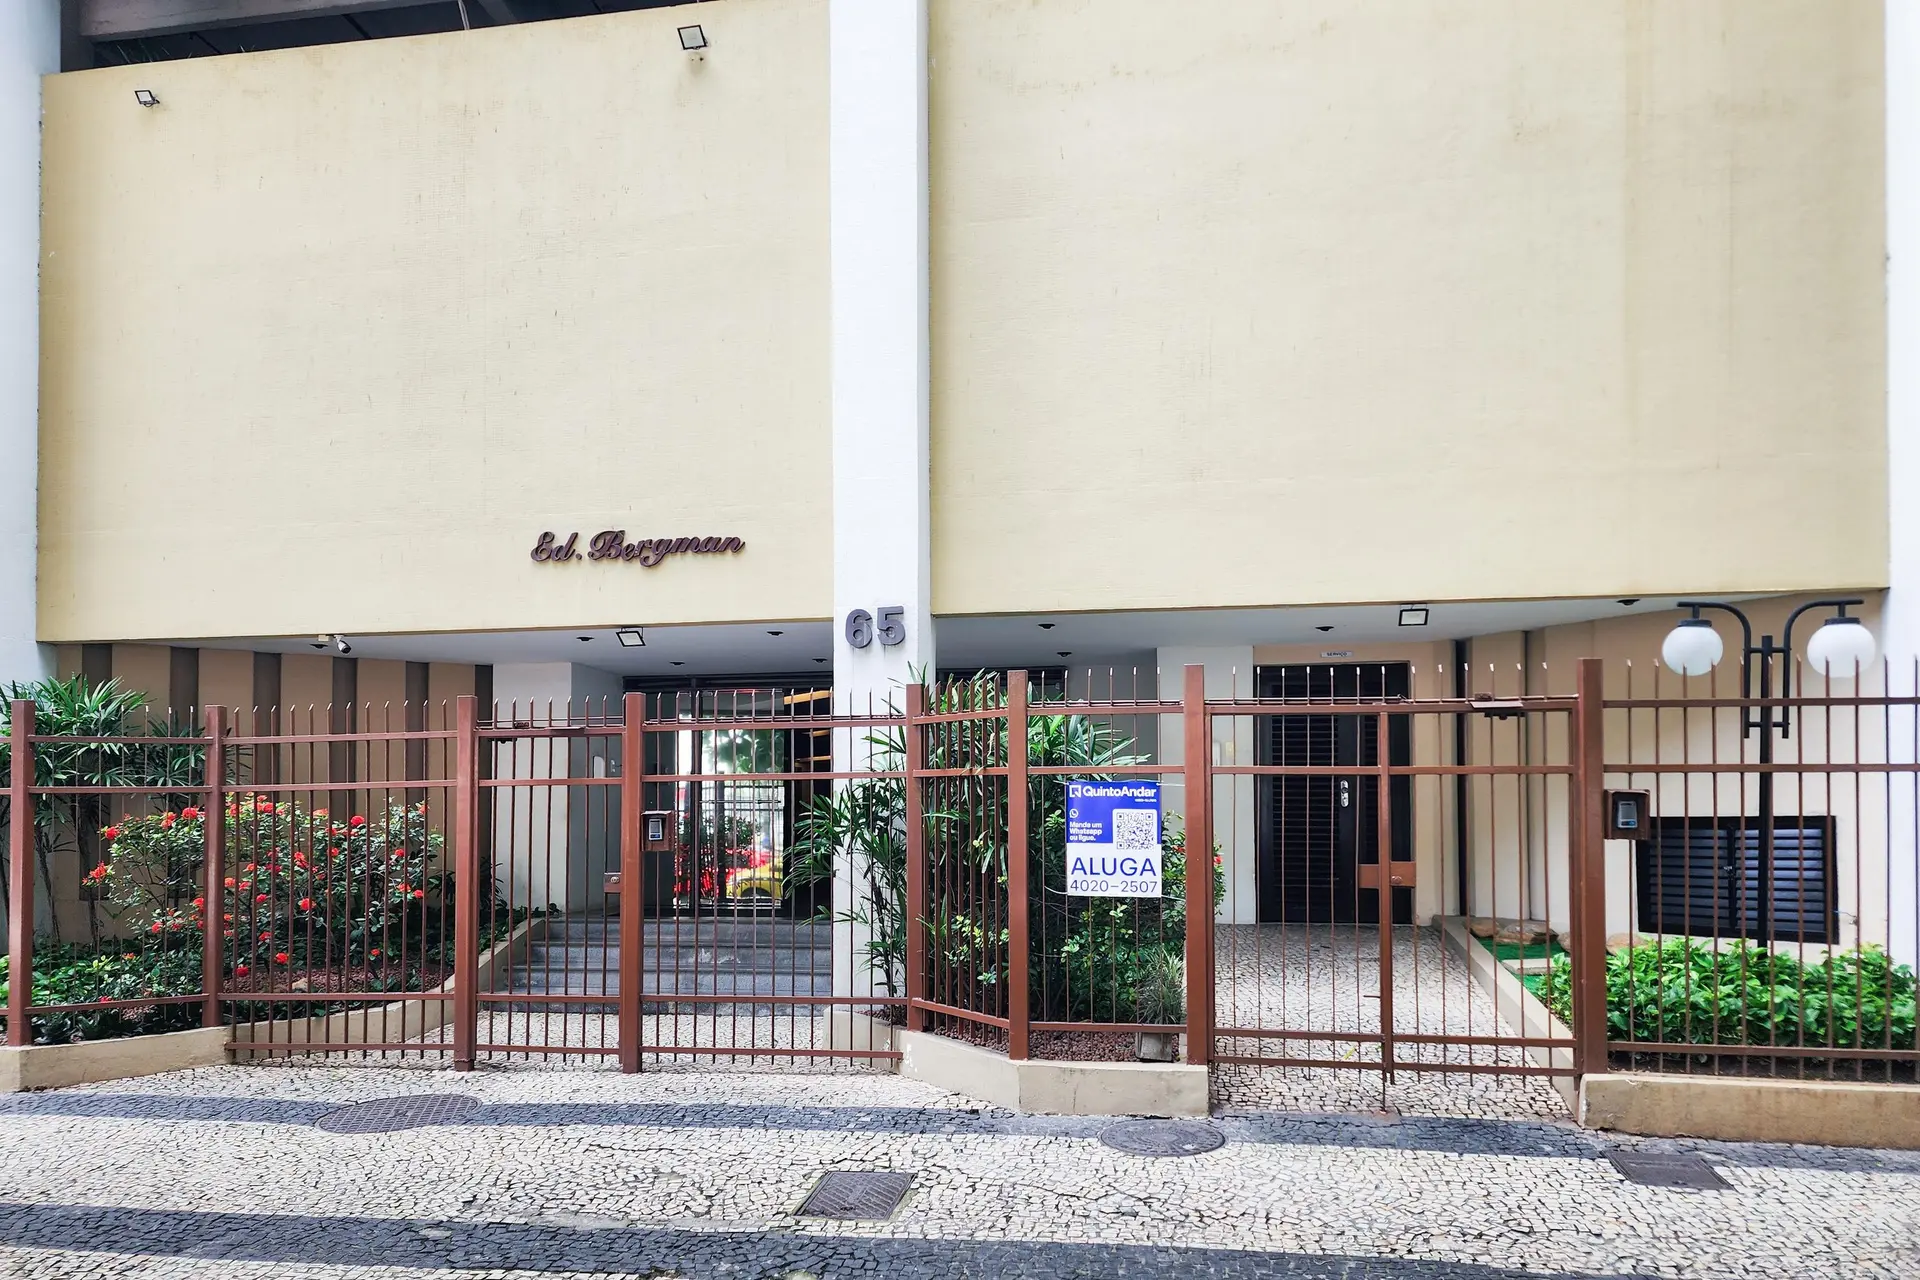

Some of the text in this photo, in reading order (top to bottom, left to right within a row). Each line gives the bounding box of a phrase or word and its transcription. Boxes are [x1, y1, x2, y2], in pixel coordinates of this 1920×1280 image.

[530, 529, 746, 567] Ed. Bergman
[844, 606, 906, 648] 65
[1082, 786, 1157, 797] QuintoAndar
[1070, 857, 1157, 877] ALUGA
[1070, 879, 1158, 893] 4020-2507
